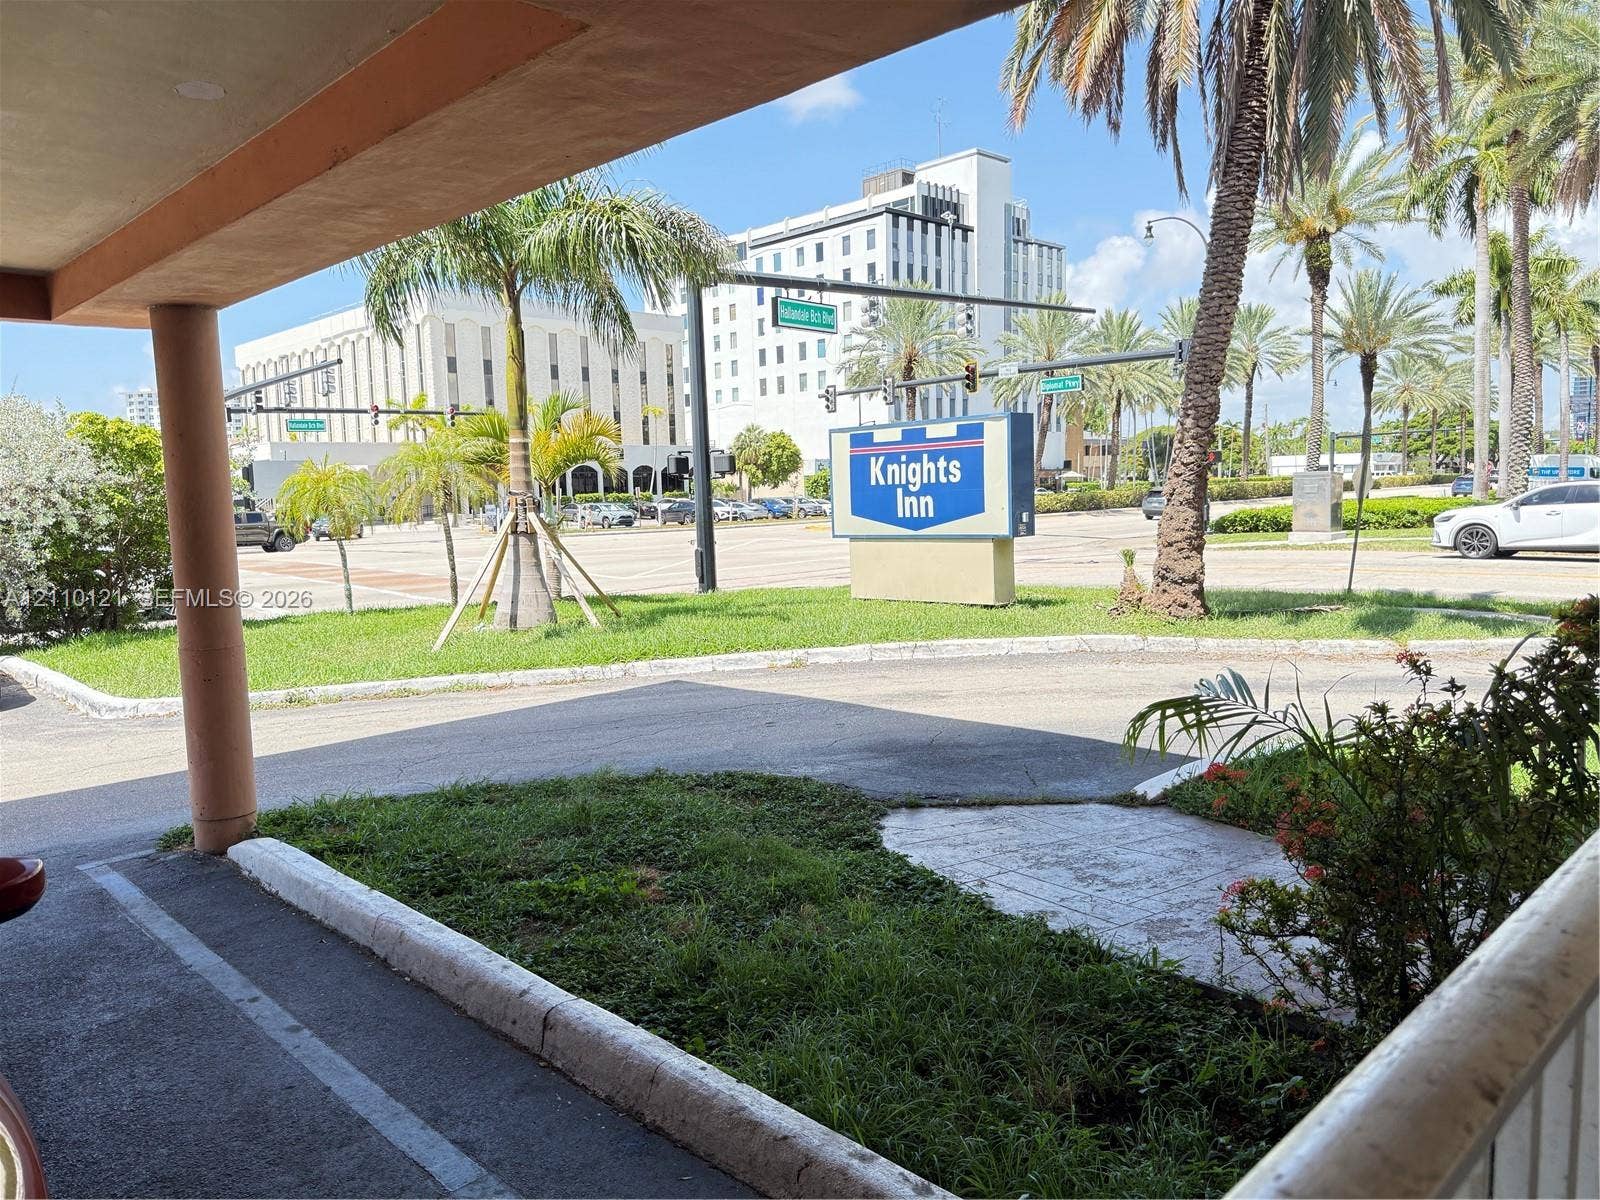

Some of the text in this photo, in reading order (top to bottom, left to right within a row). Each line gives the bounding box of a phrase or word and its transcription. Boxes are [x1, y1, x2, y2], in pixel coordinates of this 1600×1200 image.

[780, 304, 834, 325] Hallandale Bch Blvd
[1041, 379, 1079, 392] Diplomat Pkwy
[870, 453, 961, 492] Knights
[896, 487, 934, 518] Inn
